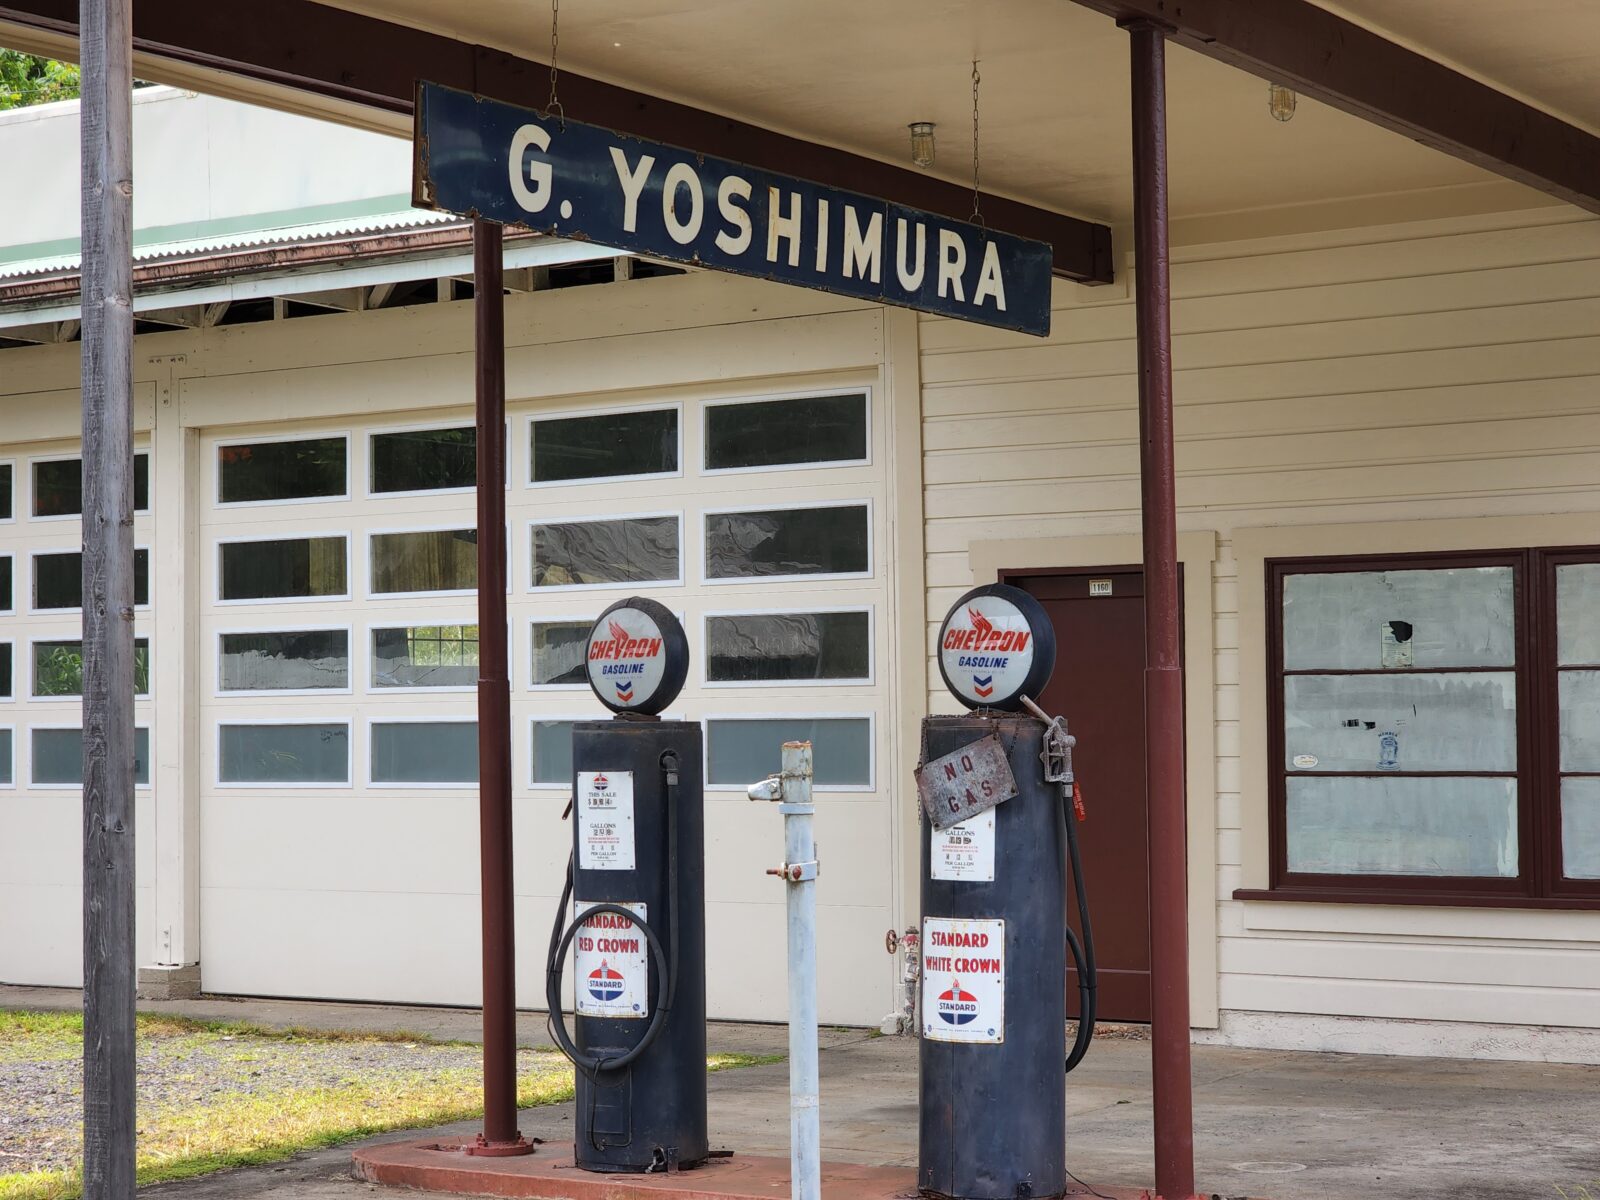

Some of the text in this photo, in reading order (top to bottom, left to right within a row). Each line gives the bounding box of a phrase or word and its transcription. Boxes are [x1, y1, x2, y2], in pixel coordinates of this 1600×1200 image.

[508, 123, 1008, 312] G. YOSHIMURA
[1093, 583, 1109, 592] 1160
[943, 623, 1031, 652] CHEVRON
[589, 633, 663, 660] CHEVRON
[602, 663, 645, 675] GASOLINE
[958, 655, 1009, 669] GASOLINE
[943, 754, 974, 782] NO
[947, 780, 993, 813] GAS
[579, 937, 639, 954] RED CROWN
[931, 931, 989, 948] STANDARD
[925, 956, 1001, 974] WHITE CROWN
[589, 980, 623, 989] STANDARD
[939, 1002, 977, 1012] STANDARD
